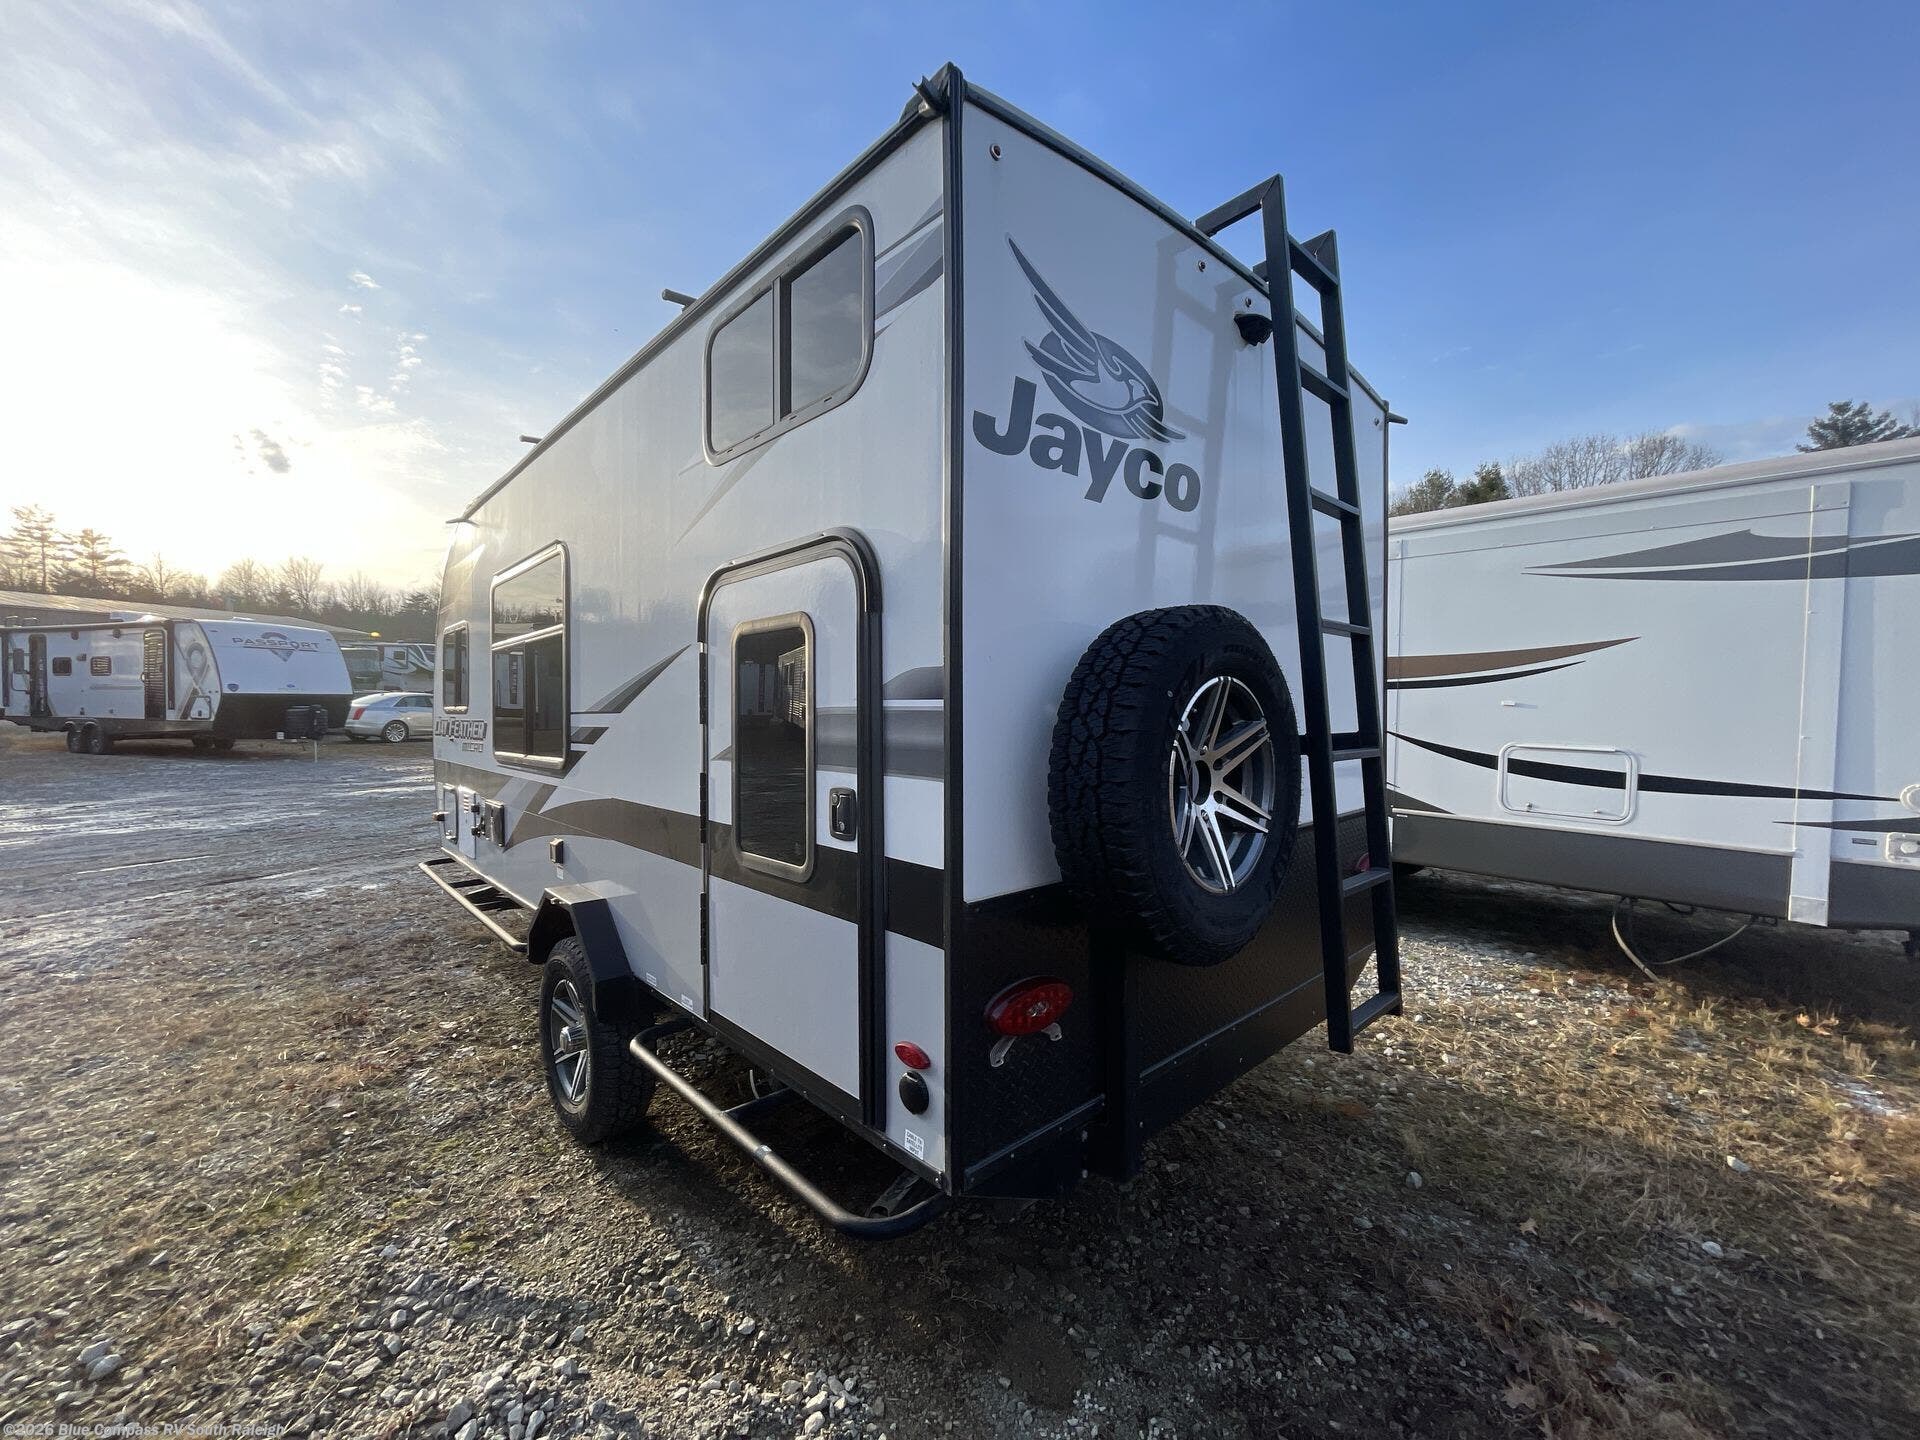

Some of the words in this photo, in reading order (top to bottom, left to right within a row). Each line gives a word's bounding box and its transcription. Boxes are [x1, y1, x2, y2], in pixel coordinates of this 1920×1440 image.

[972, 376, 1201, 513] Jayco
[232, 637, 320, 650] PASSPORT
[449, 719, 488, 740] FEATHER
